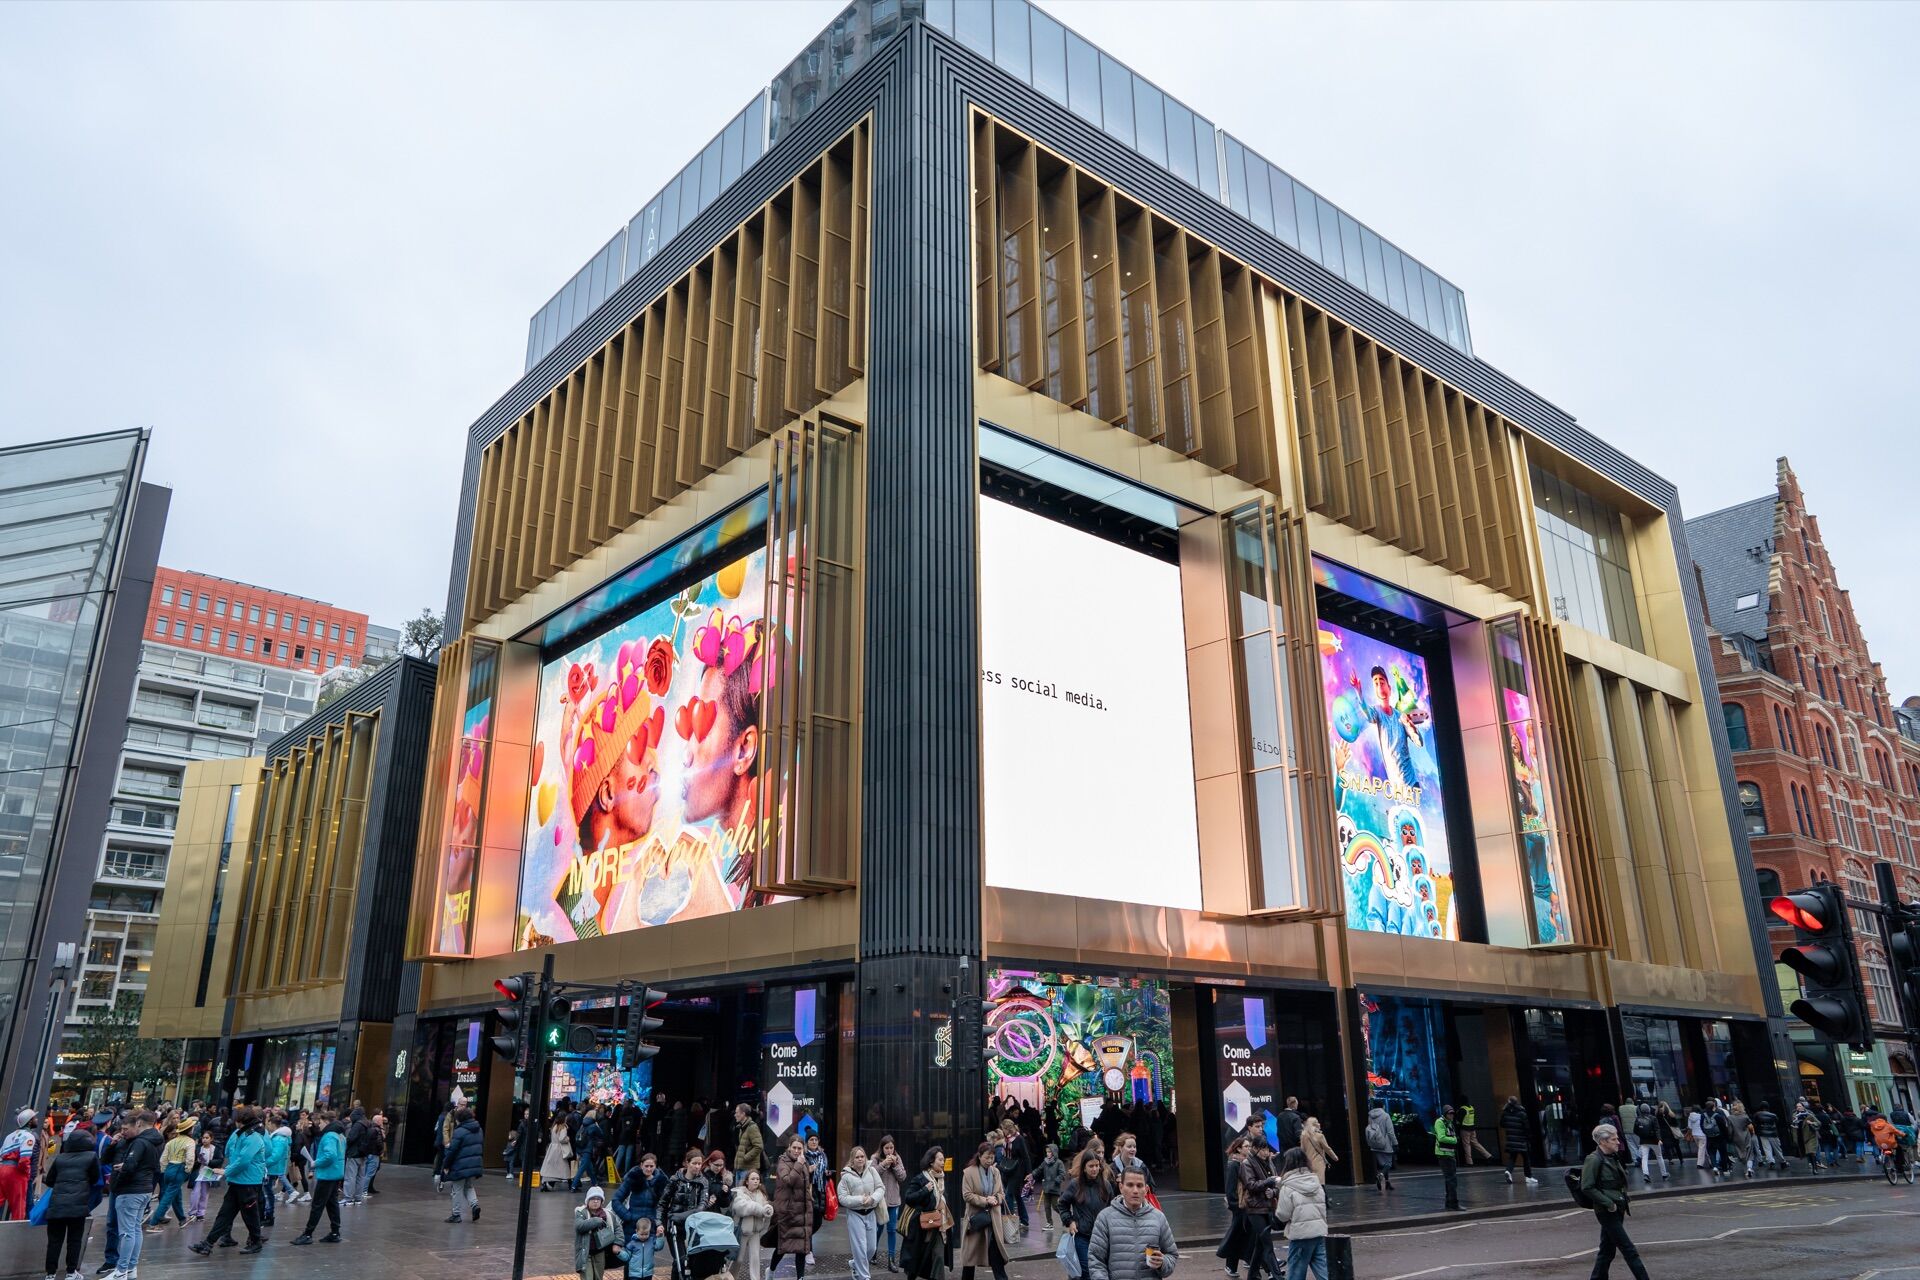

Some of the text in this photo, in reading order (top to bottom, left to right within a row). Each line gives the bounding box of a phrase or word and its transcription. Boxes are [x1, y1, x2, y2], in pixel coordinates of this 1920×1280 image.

[1011, 676, 1058, 699] social
[1065, 690, 1108, 711] media.
[1338, 769, 1422, 806] SNAPCHAT
[567, 842, 635, 896] MORE
[771, 1043, 797, 1058] Come
[1223, 1044, 1250, 1058] Come
[455, 1058, 469, 1070] Come
[777, 1062, 817, 1077] Inside
[1231, 1062, 1272, 1077] Inside
[457, 1071, 477, 1082] Inside
